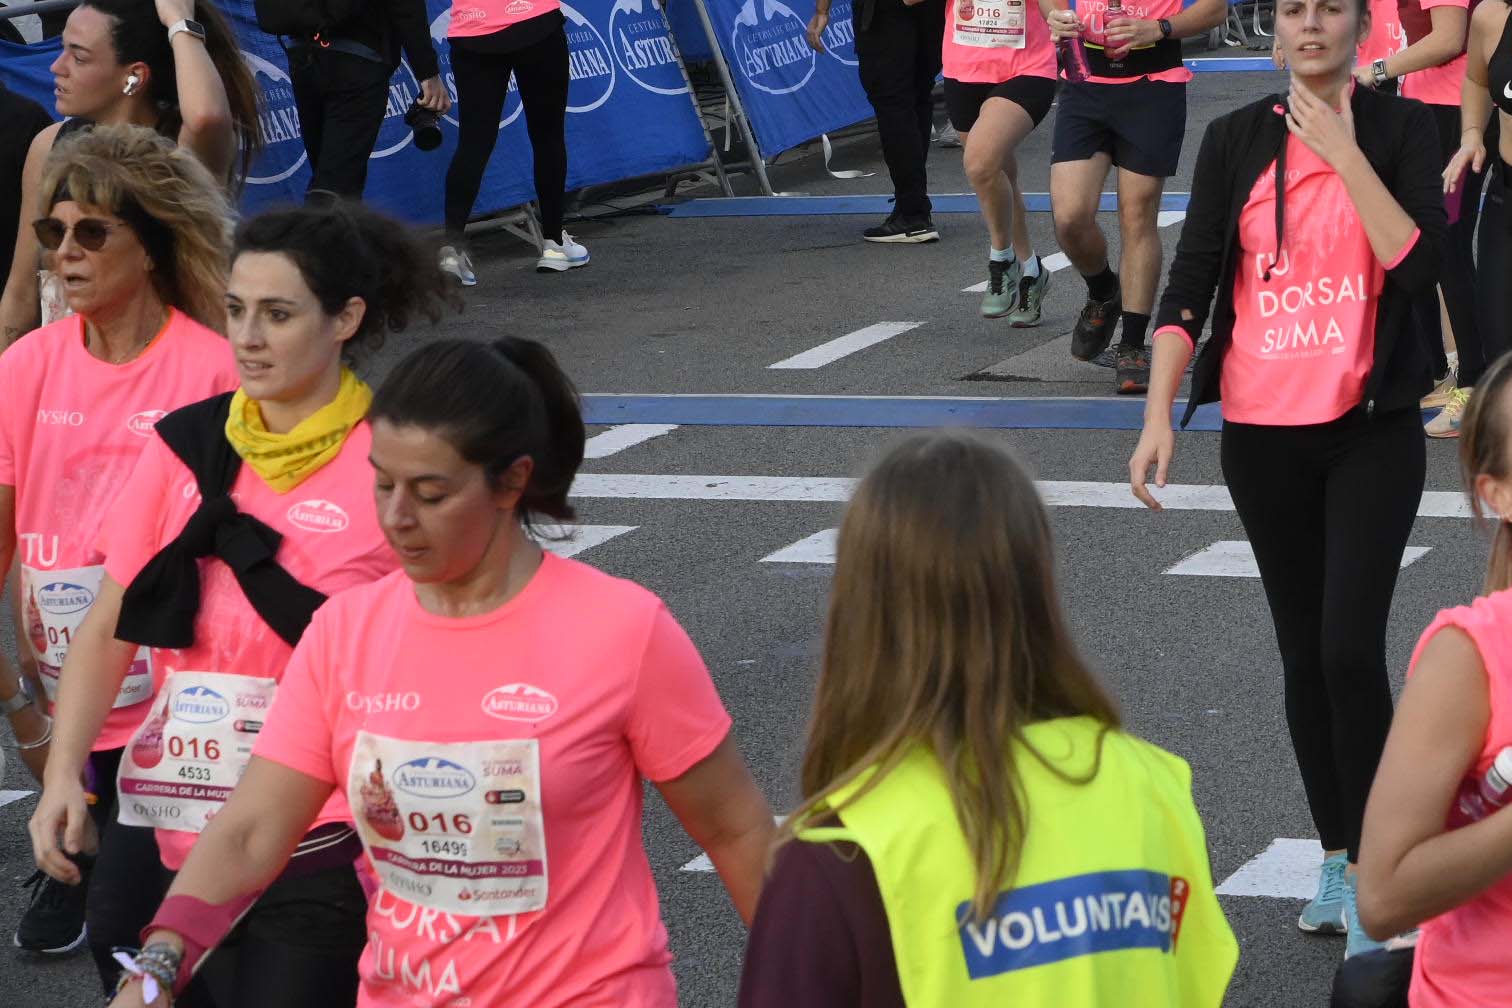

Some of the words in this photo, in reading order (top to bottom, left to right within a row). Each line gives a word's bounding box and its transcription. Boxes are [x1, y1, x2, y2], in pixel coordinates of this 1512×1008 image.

[976, 7, 1001, 18] 016
[1257, 273, 1368, 319] DORSAL
[1261, 316, 1346, 354] SUMA
[290, 507, 347, 530] ASTURIANA
[20, 533, 59, 567] TU
[48, 626, 71, 645] 01
[346, 690, 421, 714] OYSHO
[488, 696, 552, 714] ASTURIANA
[168, 735, 221, 760] 016
[178, 765, 212, 781] 4533
[399, 772, 470, 790] ASTURIANA
[135, 782, 177, 794] CARRERA
[178, 786, 193, 795] DE
[193, 788, 207, 797] LA
[207, 789, 227, 799] MUJ
[408, 811, 473, 835] 016
[444, 863, 459, 875] LA
[460, 864, 498, 877] MUJER
[472, 887, 537, 902] Santander
